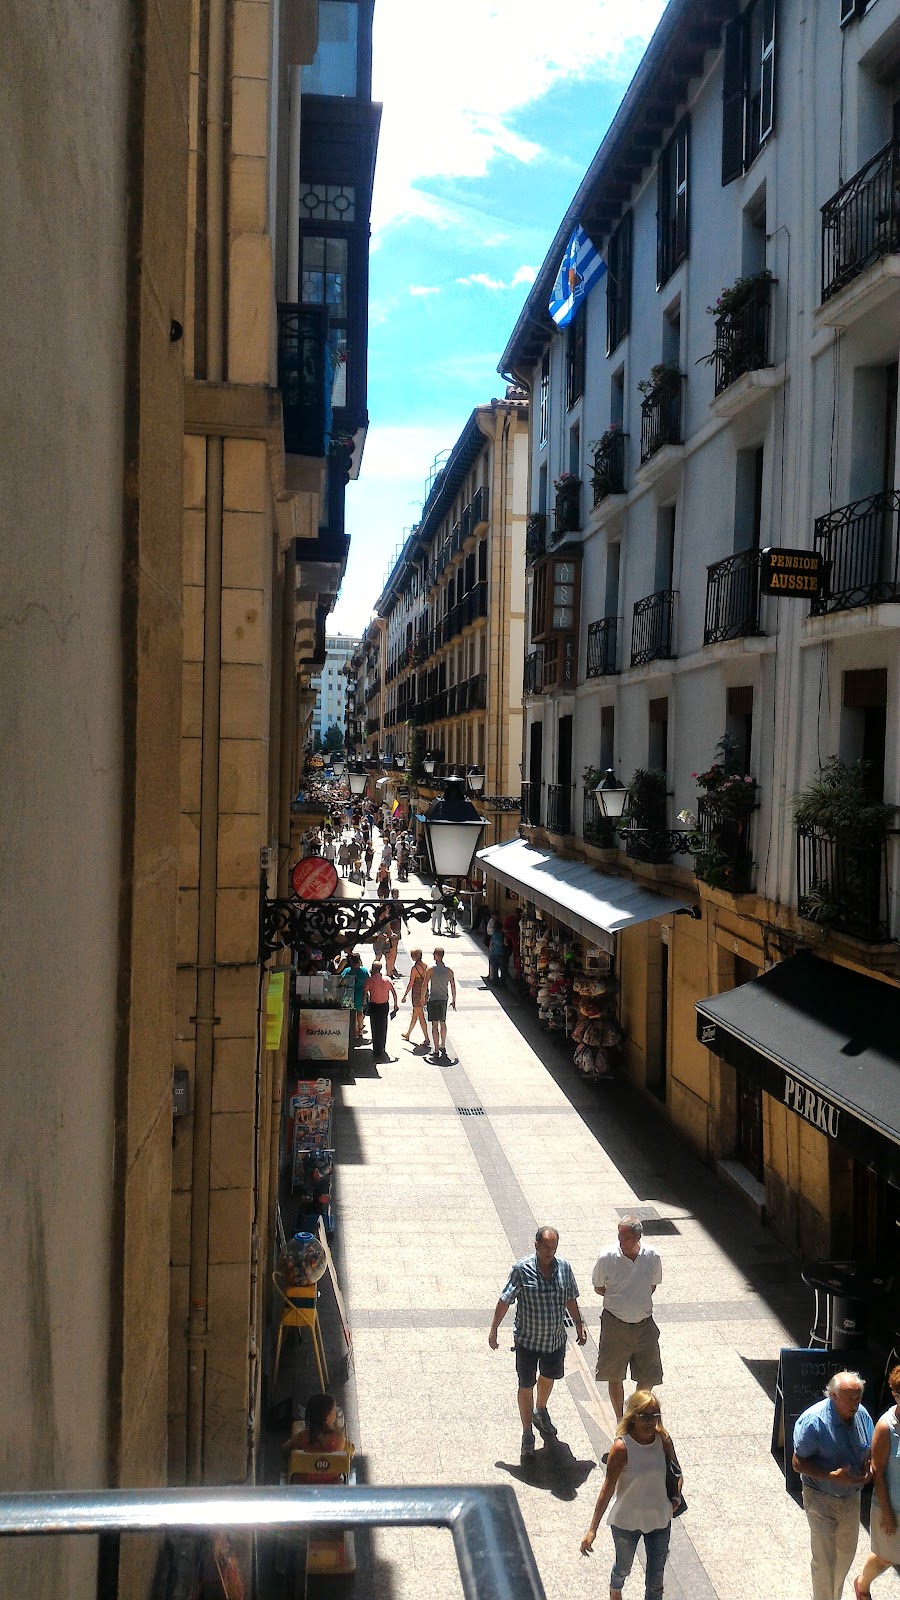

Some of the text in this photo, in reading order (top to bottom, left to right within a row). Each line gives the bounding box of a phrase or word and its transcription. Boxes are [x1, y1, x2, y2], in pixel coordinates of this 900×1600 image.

[770, 554, 819, 570] PENSION
[769, 572, 818, 591] AUSSIE
[783, 1074, 841, 1138] PERKU
